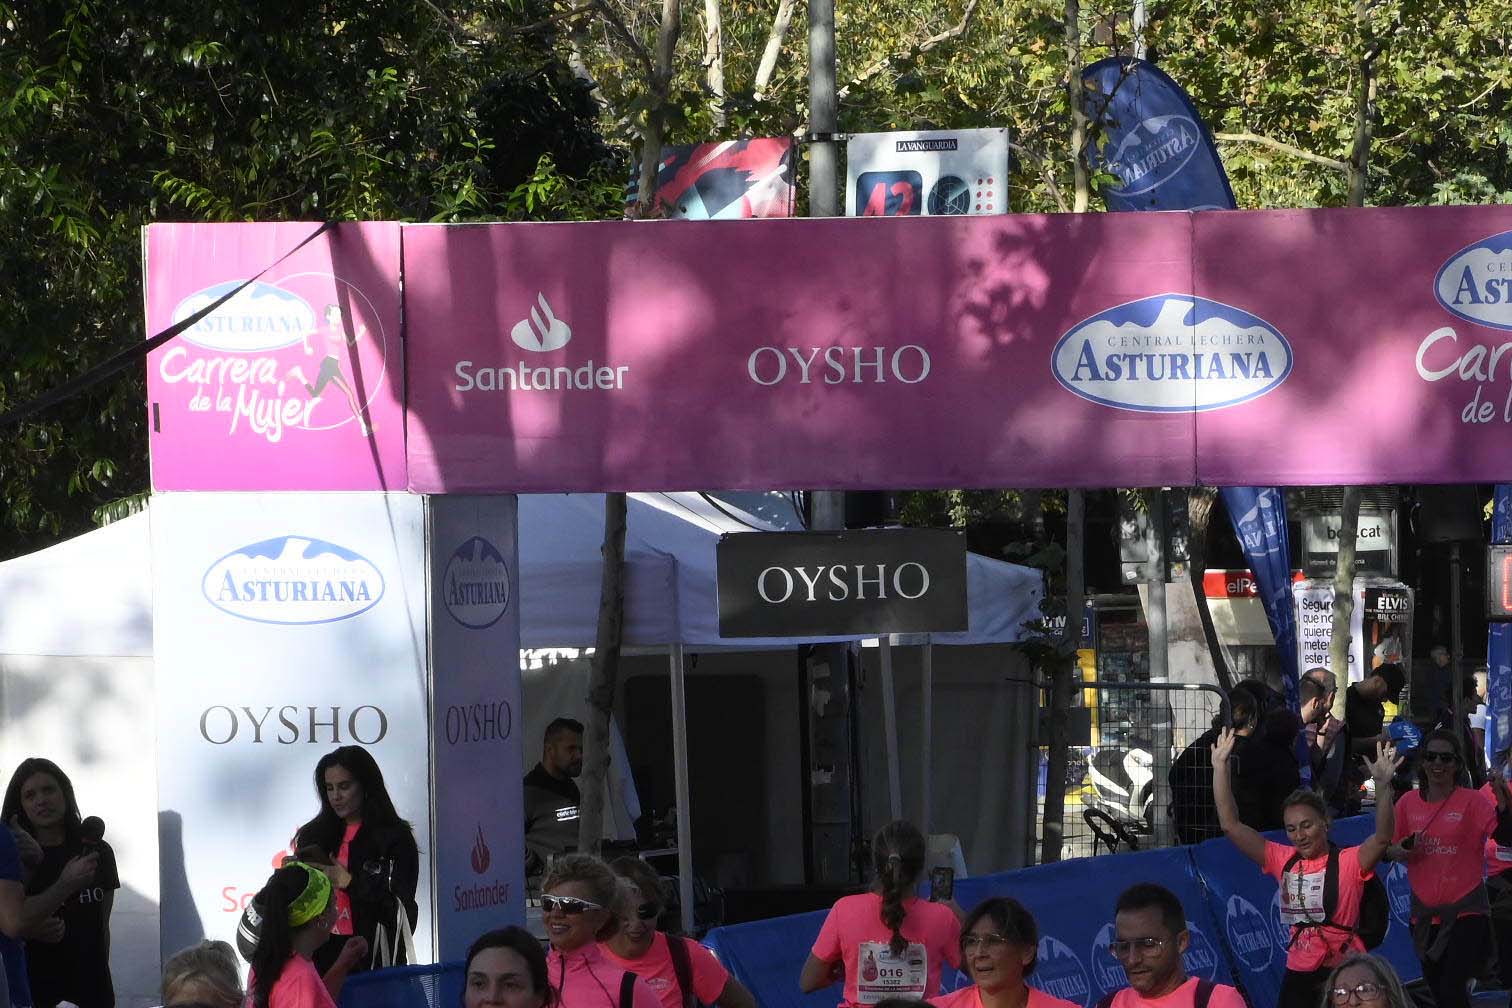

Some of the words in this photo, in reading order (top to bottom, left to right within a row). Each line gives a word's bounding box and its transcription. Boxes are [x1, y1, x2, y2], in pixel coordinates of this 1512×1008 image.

[1108, 335, 1182, 348] CENTRAL
[1190, 333, 1265, 345] LECHERA
[159, 347, 281, 384] Carrera
[455, 359, 628, 393] Santander
[748, 344, 931, 384] OYSHO
[1072, 339, 1273, 381] ASTURIANA
[190, 388, 212, 412] de
[216, 386, 232, 412] la
[231, 384, 322, 442] Mujer
[1462, 388, 1494, 422] de
[218, 570, 371, 602] ASTURIANA
[449, 573, 507, 604] ASTURIANA
[758, 563, 929, 603] OYSHO
[1303, 614, 1318, 625] que
[1378, 597, 1408, 610] ELVIS
[1305, 653, 1323, 664] este
[200, 705, 388, 745] OYSHO
[446, 700, 511, 745] OYSHO
[454, 882, 509, 912] Santander
[880, 968, 903, 977] 016
